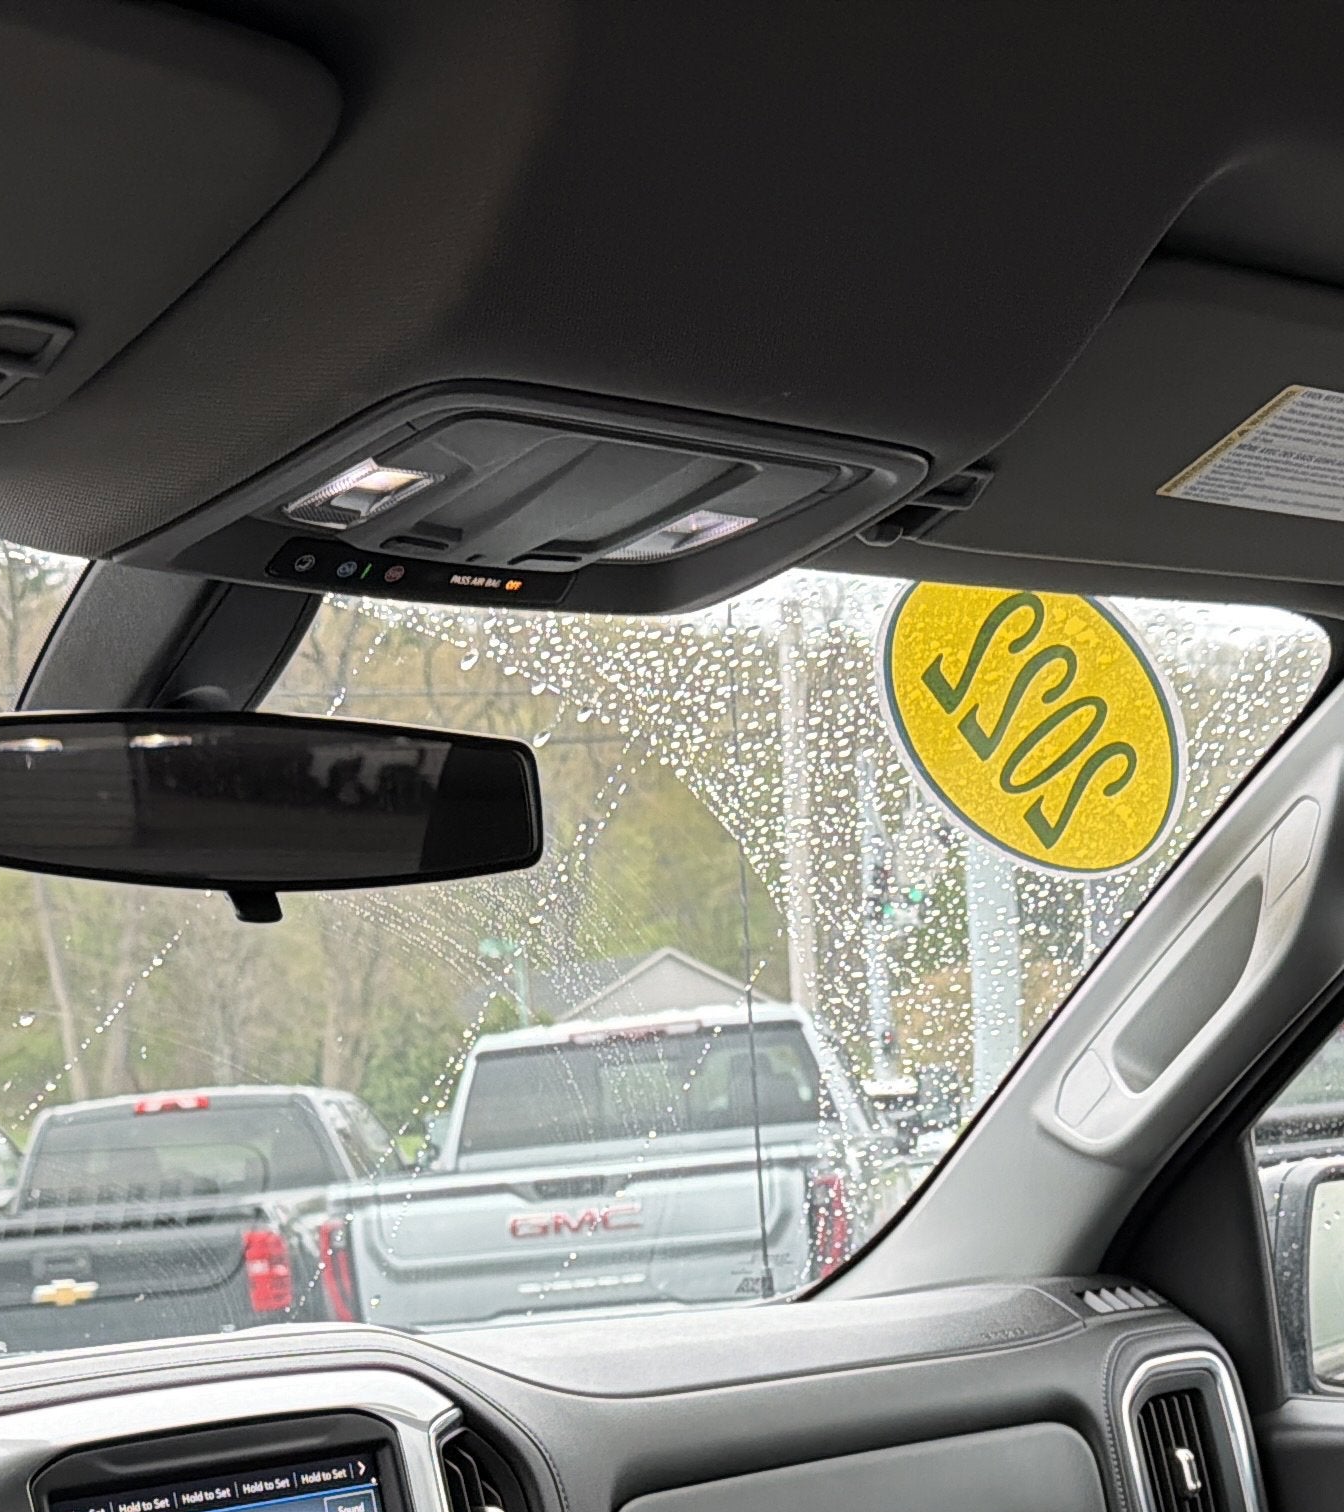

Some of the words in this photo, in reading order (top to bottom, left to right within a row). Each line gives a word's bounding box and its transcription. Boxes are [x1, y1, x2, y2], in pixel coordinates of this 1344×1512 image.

[510, 1202, 642, 1239] GMC
[300, 1471, 321, 1485] Hold
[321, 1471, 331, 1482] to
[332, 1468, 347, 1480] Set
[182, 1490, 203, 1504] Hold
[204, 1489, 214, 1500] to
[215, 1486, 231, 1499] Set
[242, 1481, 264, 1495] Hold
[265, 1480, 274, 1491] to
[274, 1477, 290, 1490] Set
[142, 1501, 152, 1511] to
[153, 1498, 170, 1510] Set
